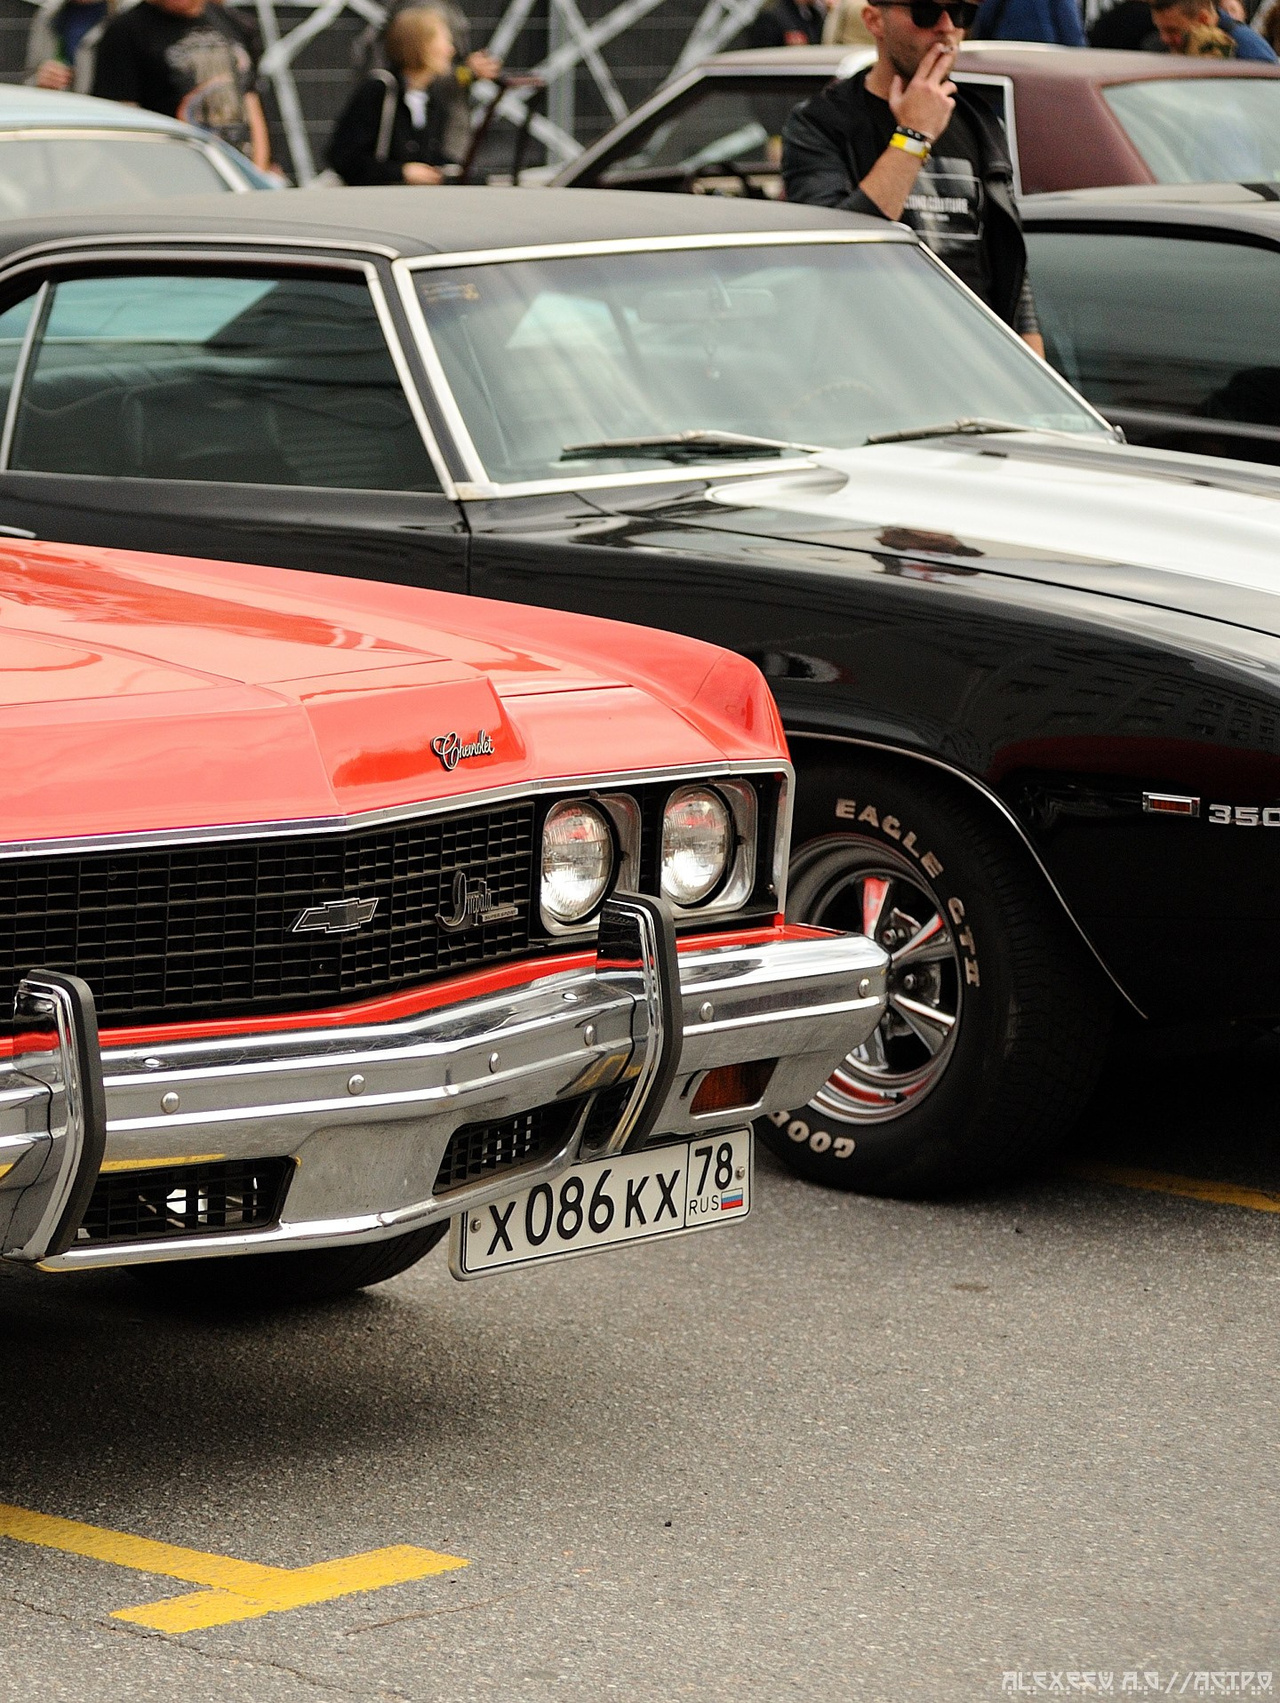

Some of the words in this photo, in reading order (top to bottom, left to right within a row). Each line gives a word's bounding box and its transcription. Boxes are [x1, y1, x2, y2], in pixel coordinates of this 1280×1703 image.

[430, 729, 495, 772] Chevrolet
[1208, 803, 1280, 827] 350
[835, 798, 944, 879] EAGLE
[694, 1142, 733, 1196] 78
[688, 1194, 719, 1216] RUS
